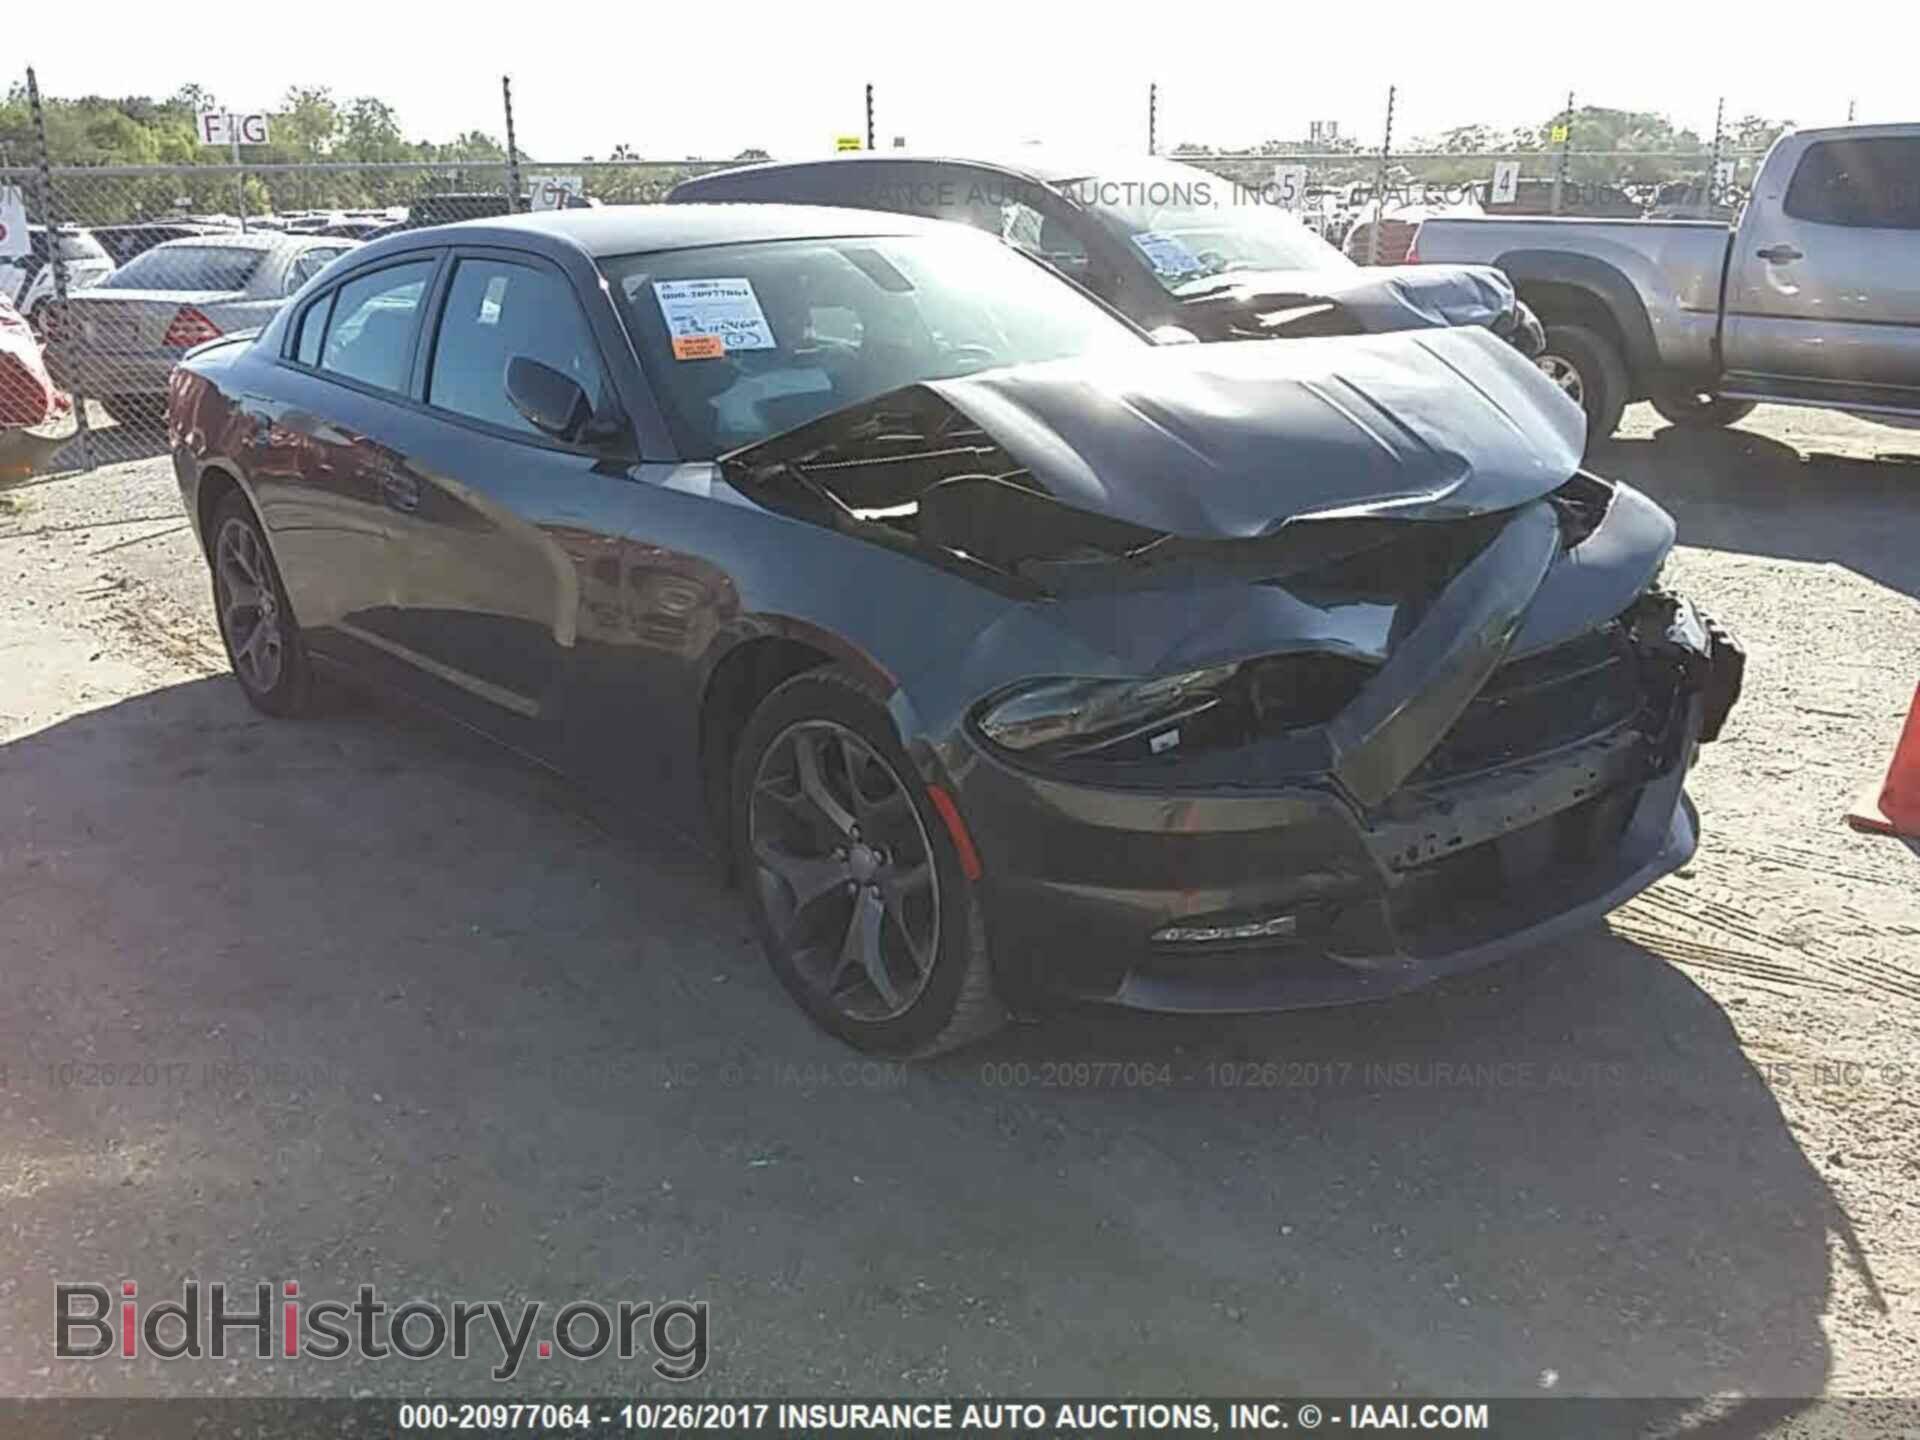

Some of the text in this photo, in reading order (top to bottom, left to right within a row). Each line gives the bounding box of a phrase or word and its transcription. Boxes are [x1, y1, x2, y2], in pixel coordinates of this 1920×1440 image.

[203, 115, 266, 143] F G
[1284, 174, 1295, 201] 5
[1499, 169, 1510, 192] 4
